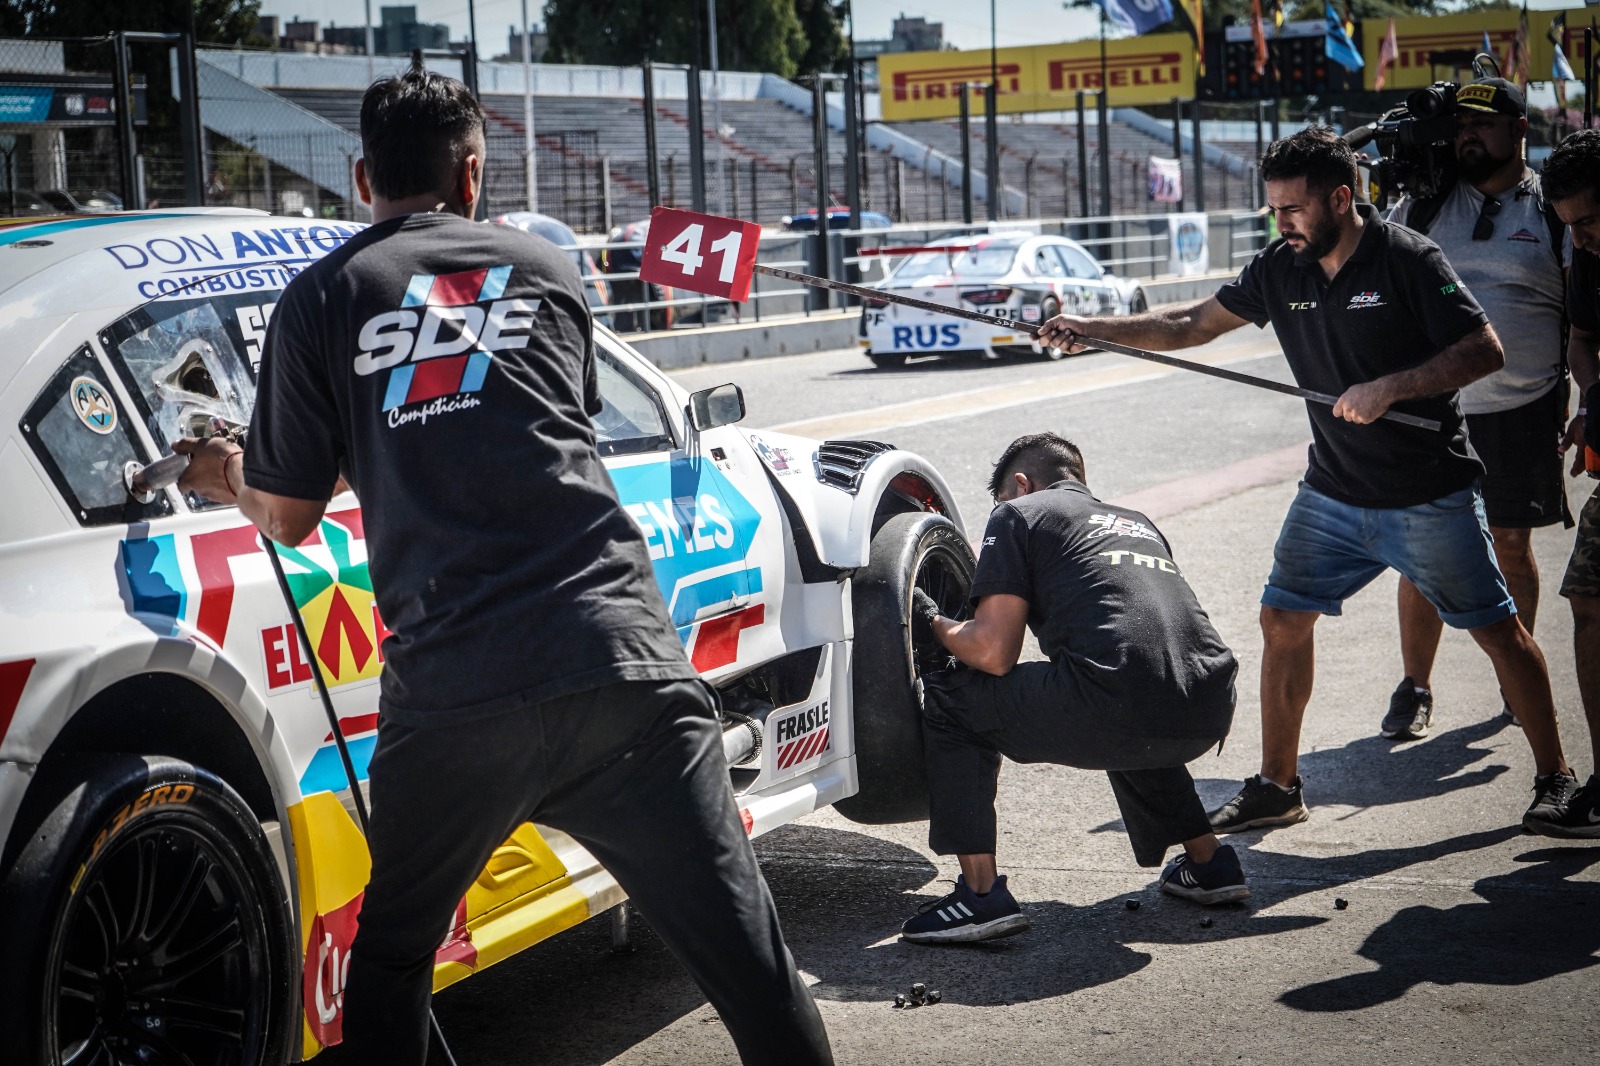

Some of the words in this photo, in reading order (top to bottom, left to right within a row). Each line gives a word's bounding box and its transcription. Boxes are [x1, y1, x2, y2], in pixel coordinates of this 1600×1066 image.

[1048, 53, 1182, 91] PIRELLI
[104, 233, 225, 270] DON
[660, 222, 743, 284] 41
[1350, 295, 1381, 303] SDE
[353, 298, 542, 377] SDE
[893, 324, 961, 349] RUS
[388, 395, 481, 428] Competición
